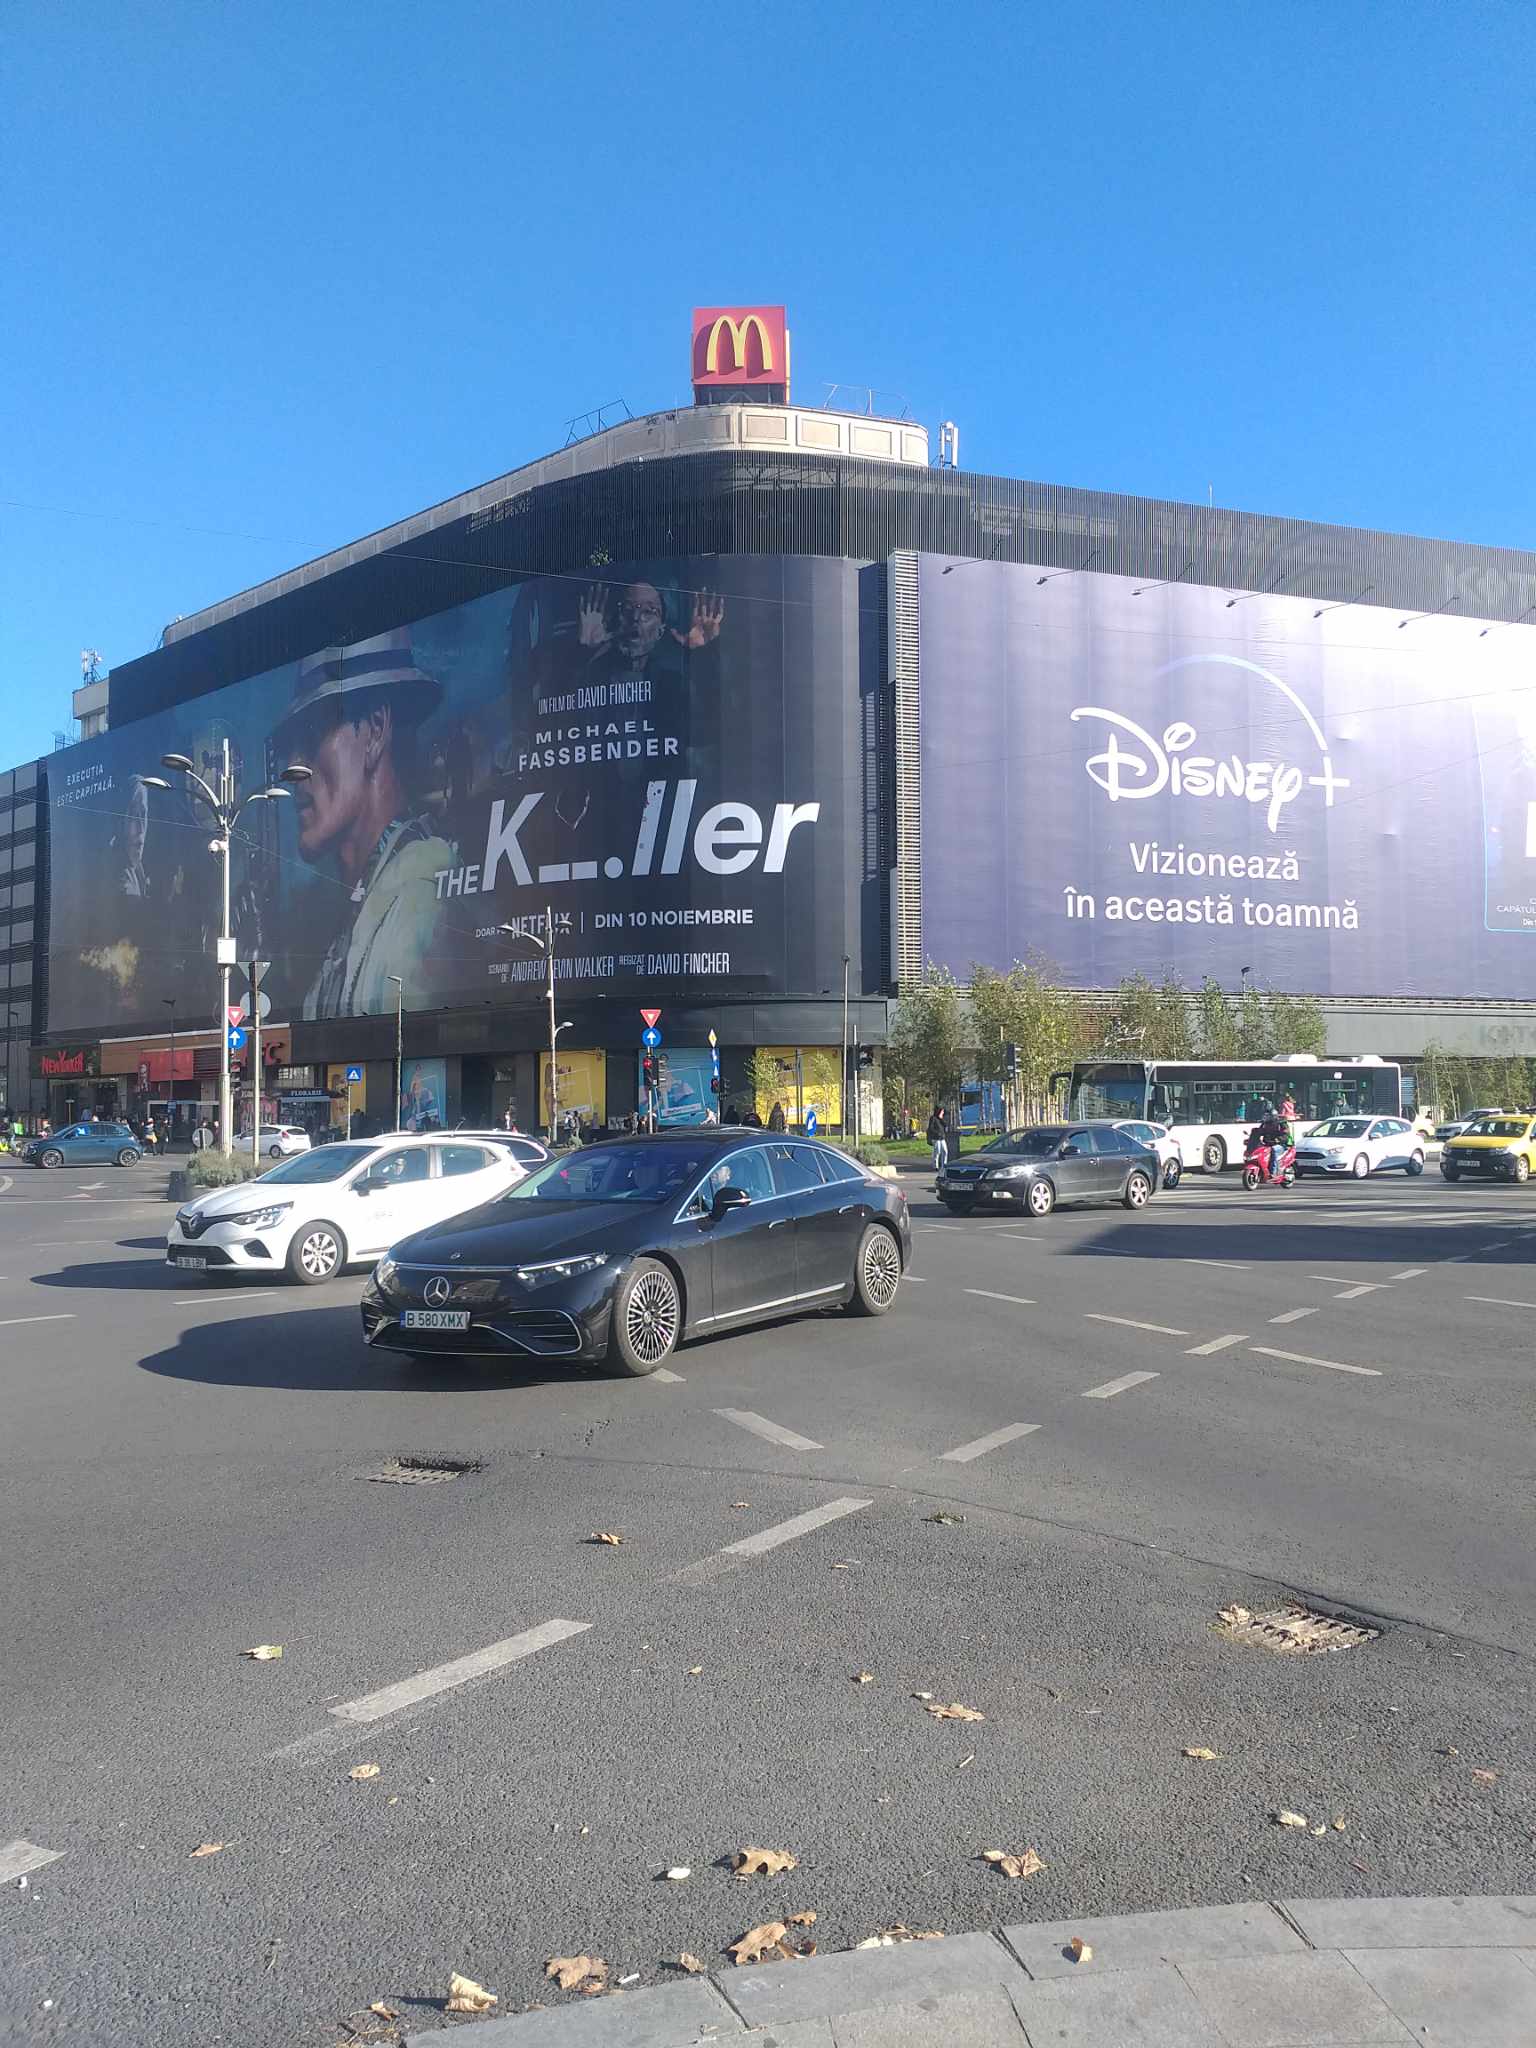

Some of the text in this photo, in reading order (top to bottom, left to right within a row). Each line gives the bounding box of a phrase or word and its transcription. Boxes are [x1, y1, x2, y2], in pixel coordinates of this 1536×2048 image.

[538, 680, 651, 715] UN FILM DE DAVID FINCHER
[535, 720, 655, 745] MICHAEL
[518, 737, 679, 772] FASSBENDER
[1129, 842, 1300, 880] Vizionează
[434, 864, 480, 899] THE
[595, 909, 754, 929] DIN 10 NOIEMBRIE
[1064, 886, 1359, 929] în această toamnă
[551, 958, 573, 980] EVIN
[574, 955, 614, 978] WALKER
[647, 952, 730, 975] DAVID FINCHER
[406, 1312, 415, 1327] B
